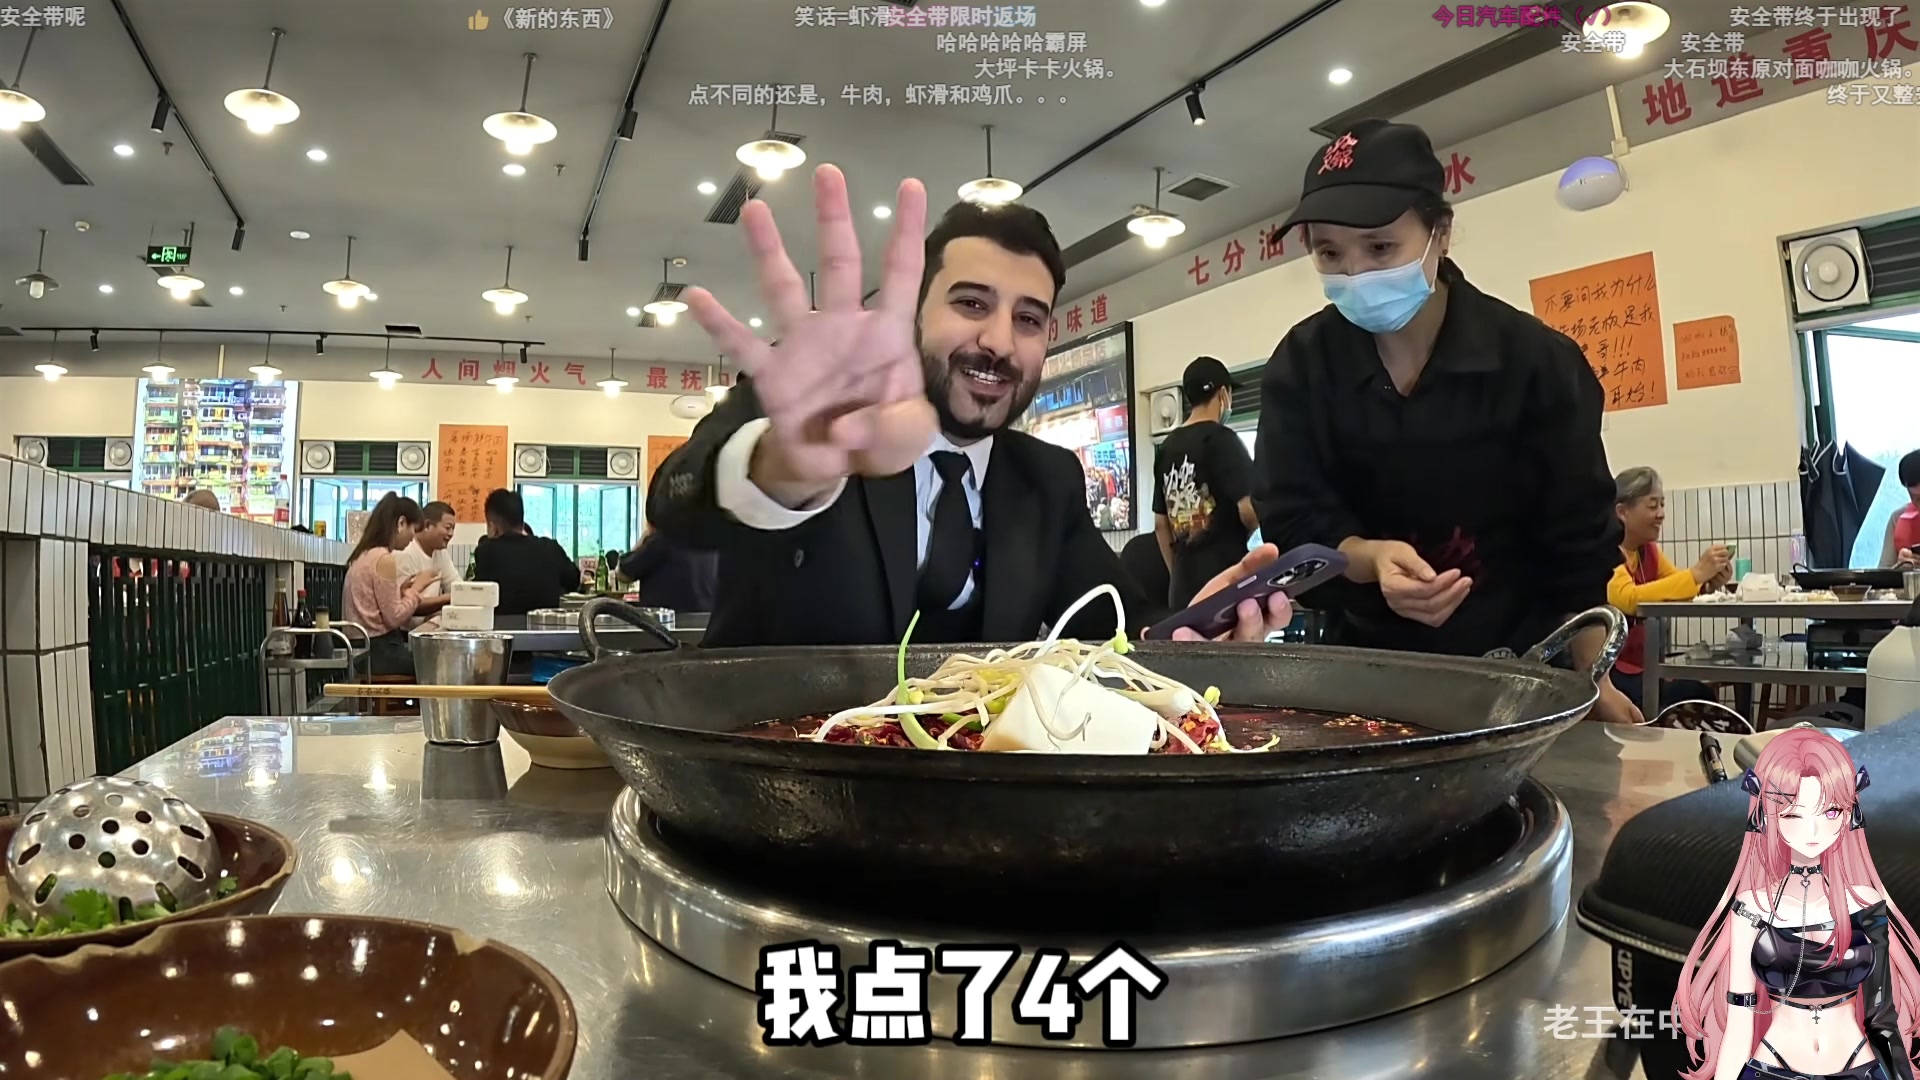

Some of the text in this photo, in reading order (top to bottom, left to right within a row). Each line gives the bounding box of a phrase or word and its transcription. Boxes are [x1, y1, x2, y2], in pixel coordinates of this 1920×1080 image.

[1545, 273, 1656, 315] 不要问我为什么
